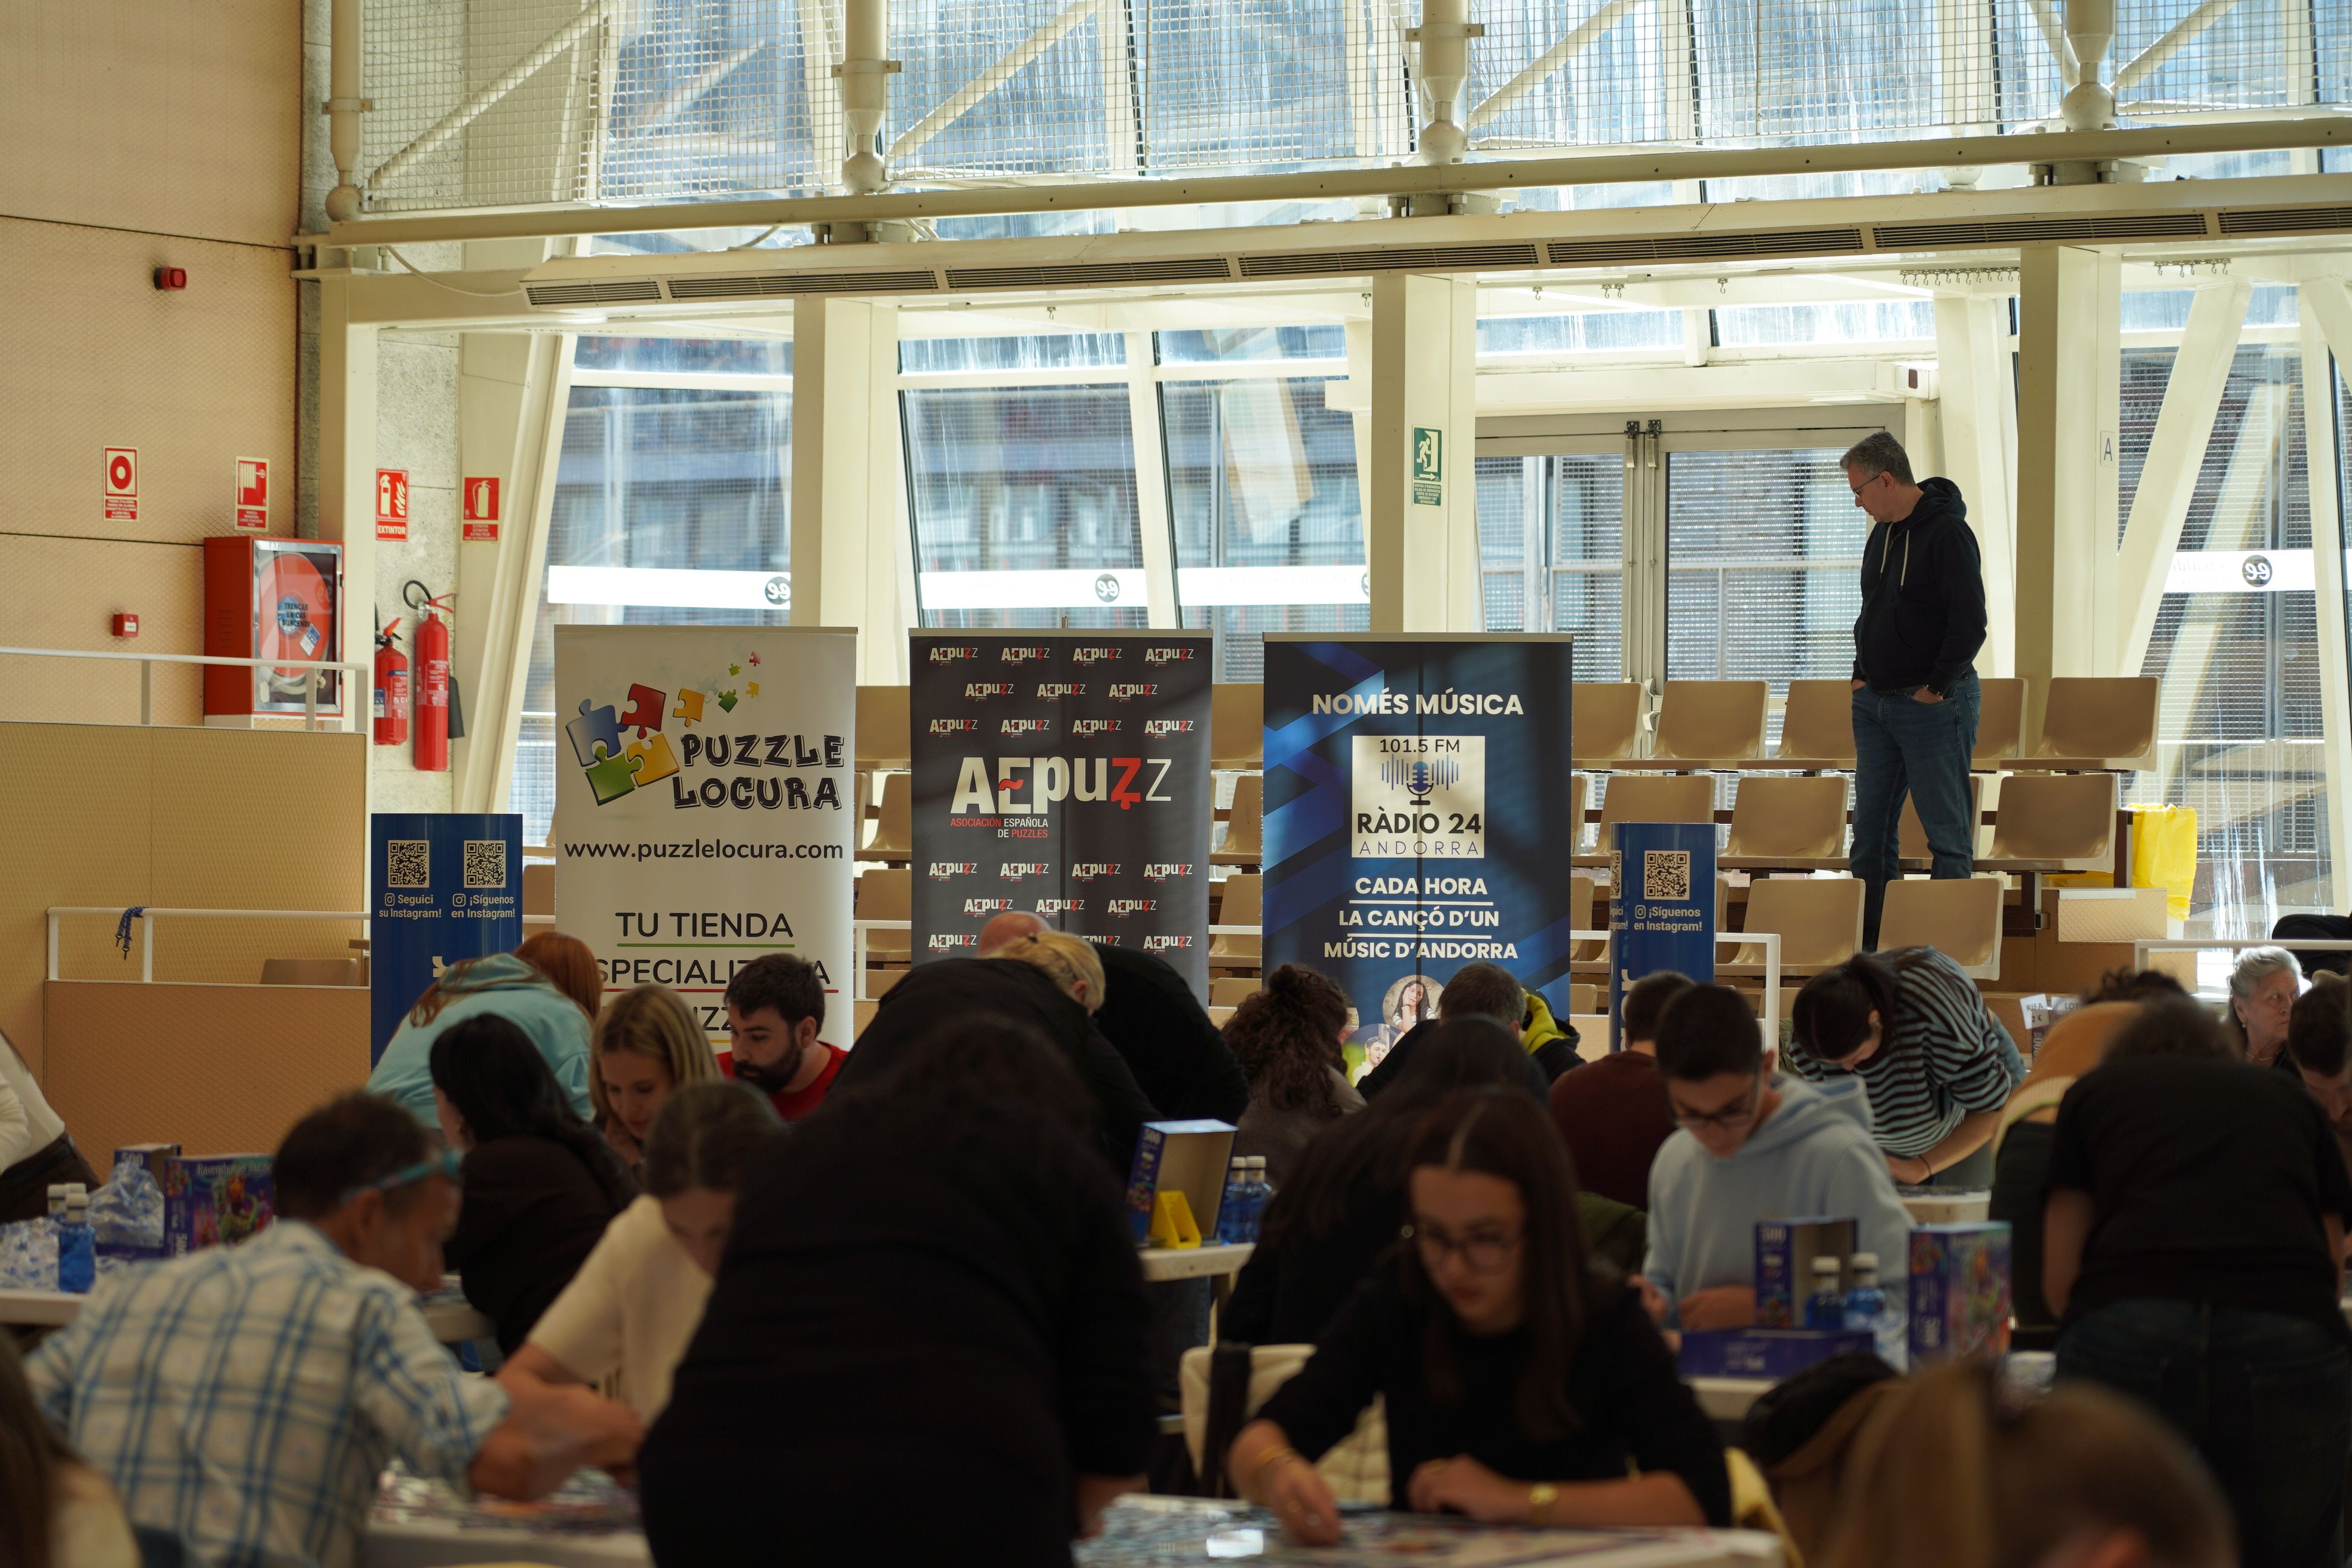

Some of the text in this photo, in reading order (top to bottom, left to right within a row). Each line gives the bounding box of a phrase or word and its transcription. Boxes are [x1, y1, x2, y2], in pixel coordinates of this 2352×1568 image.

[2103, 437, 2113, 462] A
[378, 525, 406, 535] EXTINTOR
[284, 602, 309, 611] TRENCAR
[1312, 687, 1524, 715] NOMÉS MÚSICA
[680, 734, 844, 767] PUZZLE
[1380, 739, 1460, 753] 101.5 FM
[672, 776, 842, 810] LOCURA
[950, 816, 1048, 828] ASOCIACIÓN ESPAÑOLA
[1357, 806, 1481, 834] RÀDIO 24
[998, 829, 1048, 838] DE PUZZLES
[564, 838, 843, 862] www.puzzlelocura.com
[1359, 841, 1479, 855] ANDORRA
[1355, 877, 1488, 895] CADA HORA
[397, 895, 434, 906] Seguici
[470, 895, 514, 906] ¡Síguenos
[390, 908, 442, 920] Instagram!
[467, 908, 515, 920] Instagram!
[1339, 905, 1499, 932] LA CANÇÓ D'UN
[1649, 906, 1701, 918] ¡Síguenos
[615, 912, 794, 938] TU TIENDA
[1646, 921, 1702, 933] Instagram!
[1324, 938, 1518, 959] MÚSIC D'ANDORRA
[596, 959, 831, 985] SPECIALIA
[2026, 1003, 2044, 1011] RIFA
